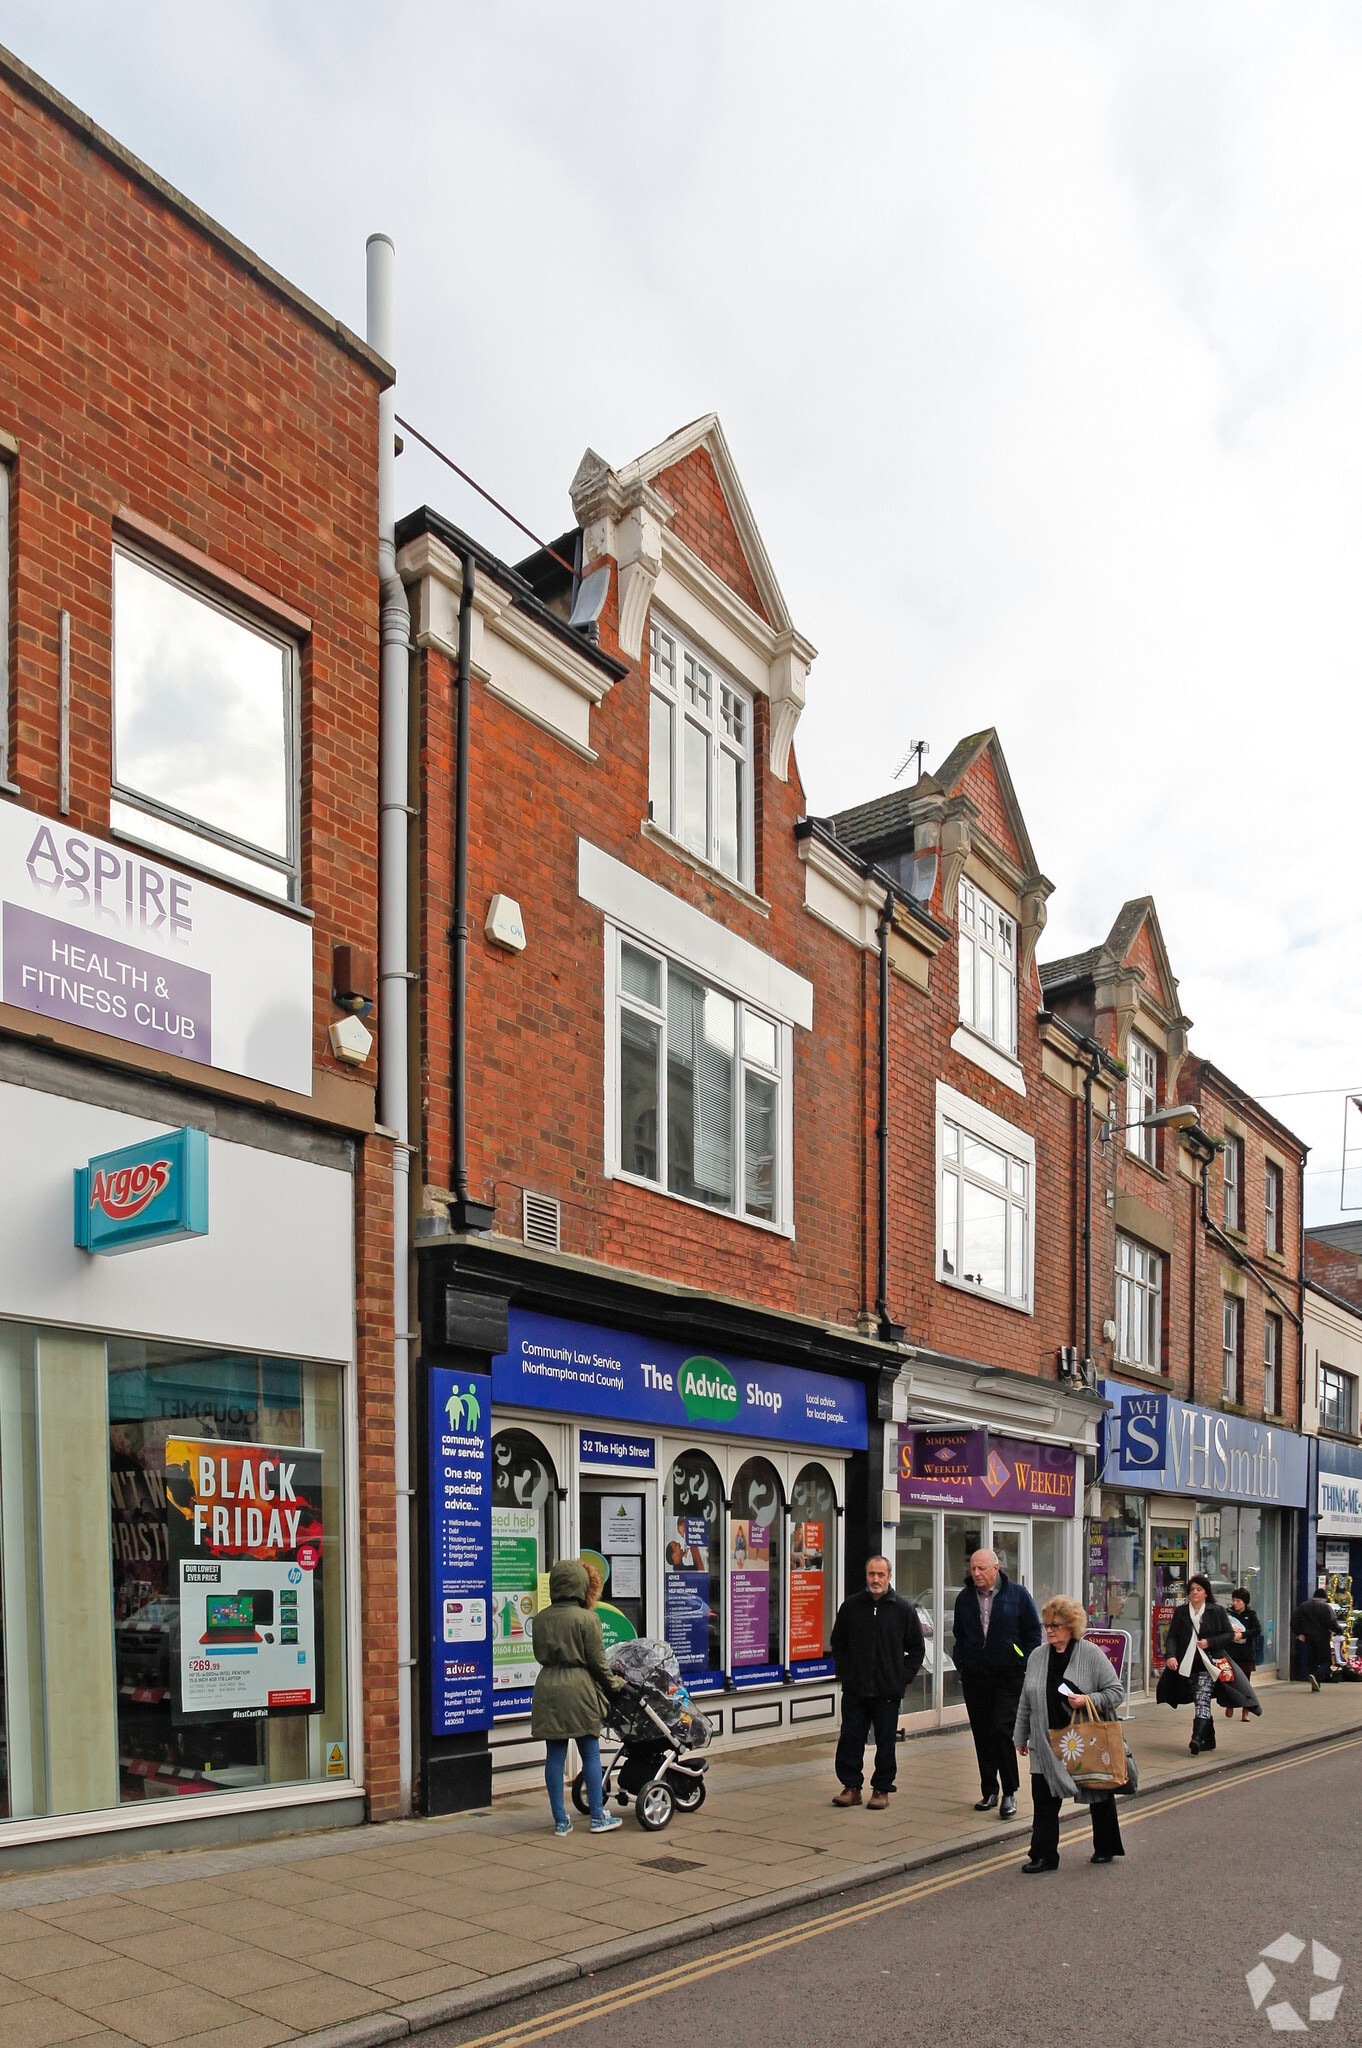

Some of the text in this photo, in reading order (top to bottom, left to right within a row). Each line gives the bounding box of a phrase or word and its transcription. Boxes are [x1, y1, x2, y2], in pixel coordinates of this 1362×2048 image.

[26, 825, 192, 925] ASPIRE
[52, 939, 170, 999] HEALTH &
[22, 964, 196, 1040] FITNESS CLUB
[89, 1160, 173, 1219] Argos
[521, 1340, 621, 1371] Community Law Service
[522, 1360, 624, 1391] (Northampton and County)
[641, 1363, 782, 1414] The Advice Shop
[805, 1393, 836, 1408] Local advice
[1128, 1400, 1159, 1415] WH
[806, 1407, 814, 1418] for
[814, 1408, 826, 1420] local
[441, 1435, 485, 1449] community
[926, 1436, 966, 1446] SIMPSON
[1125, 1415, 1159, 1465] S
[442, 1445, 485, 1459] law service
[582, 1440, 650, 1458] 32 The High Street
[941, 1450, 949, 1459] &
[444, 1467, 482, 1482] One stop
[923, 1464, 969, 1474] WEEKLEY
[198, 1456, 297, 1502] BLACK
[1013, 1461, 1074, 1497] WEEKLEY
[111, 1469, 167, 1508] N'T W
[444, 1484, 483, 1496] specialist
[444, 1498, 479, 1511] advice...
[1321, 1483, 1362, 1514] THING-ME-
[194, 1504, 301, 1548] FRIDAY
[513, 1513, 535, 1531] help
[1091, 1524, 1102, 1533] OUT
[448, 1536, 466, 1544] Housing
[1089, 1536, 1103, 1545] NOW
[448, 1552, 463, 1560] Energy
[1091, 1548, 1101, 1556] 2016
[185, 1565, 219, 1573] OUR LOWEST
[448, 1560, 475, 1568] Immigration
[187, 1574, 218, 1582] EVER PRICE
[289, 1567, 301, 1584] hp
[1089, 1636, 1120, 1644] SIMPSON
[188, 1660, 220, 1671] £269.99
[446, 1664, 475, 1675] advice
[444, 1690, 467, 1699] Registered
[444, 1710, 465, 1718] Company
